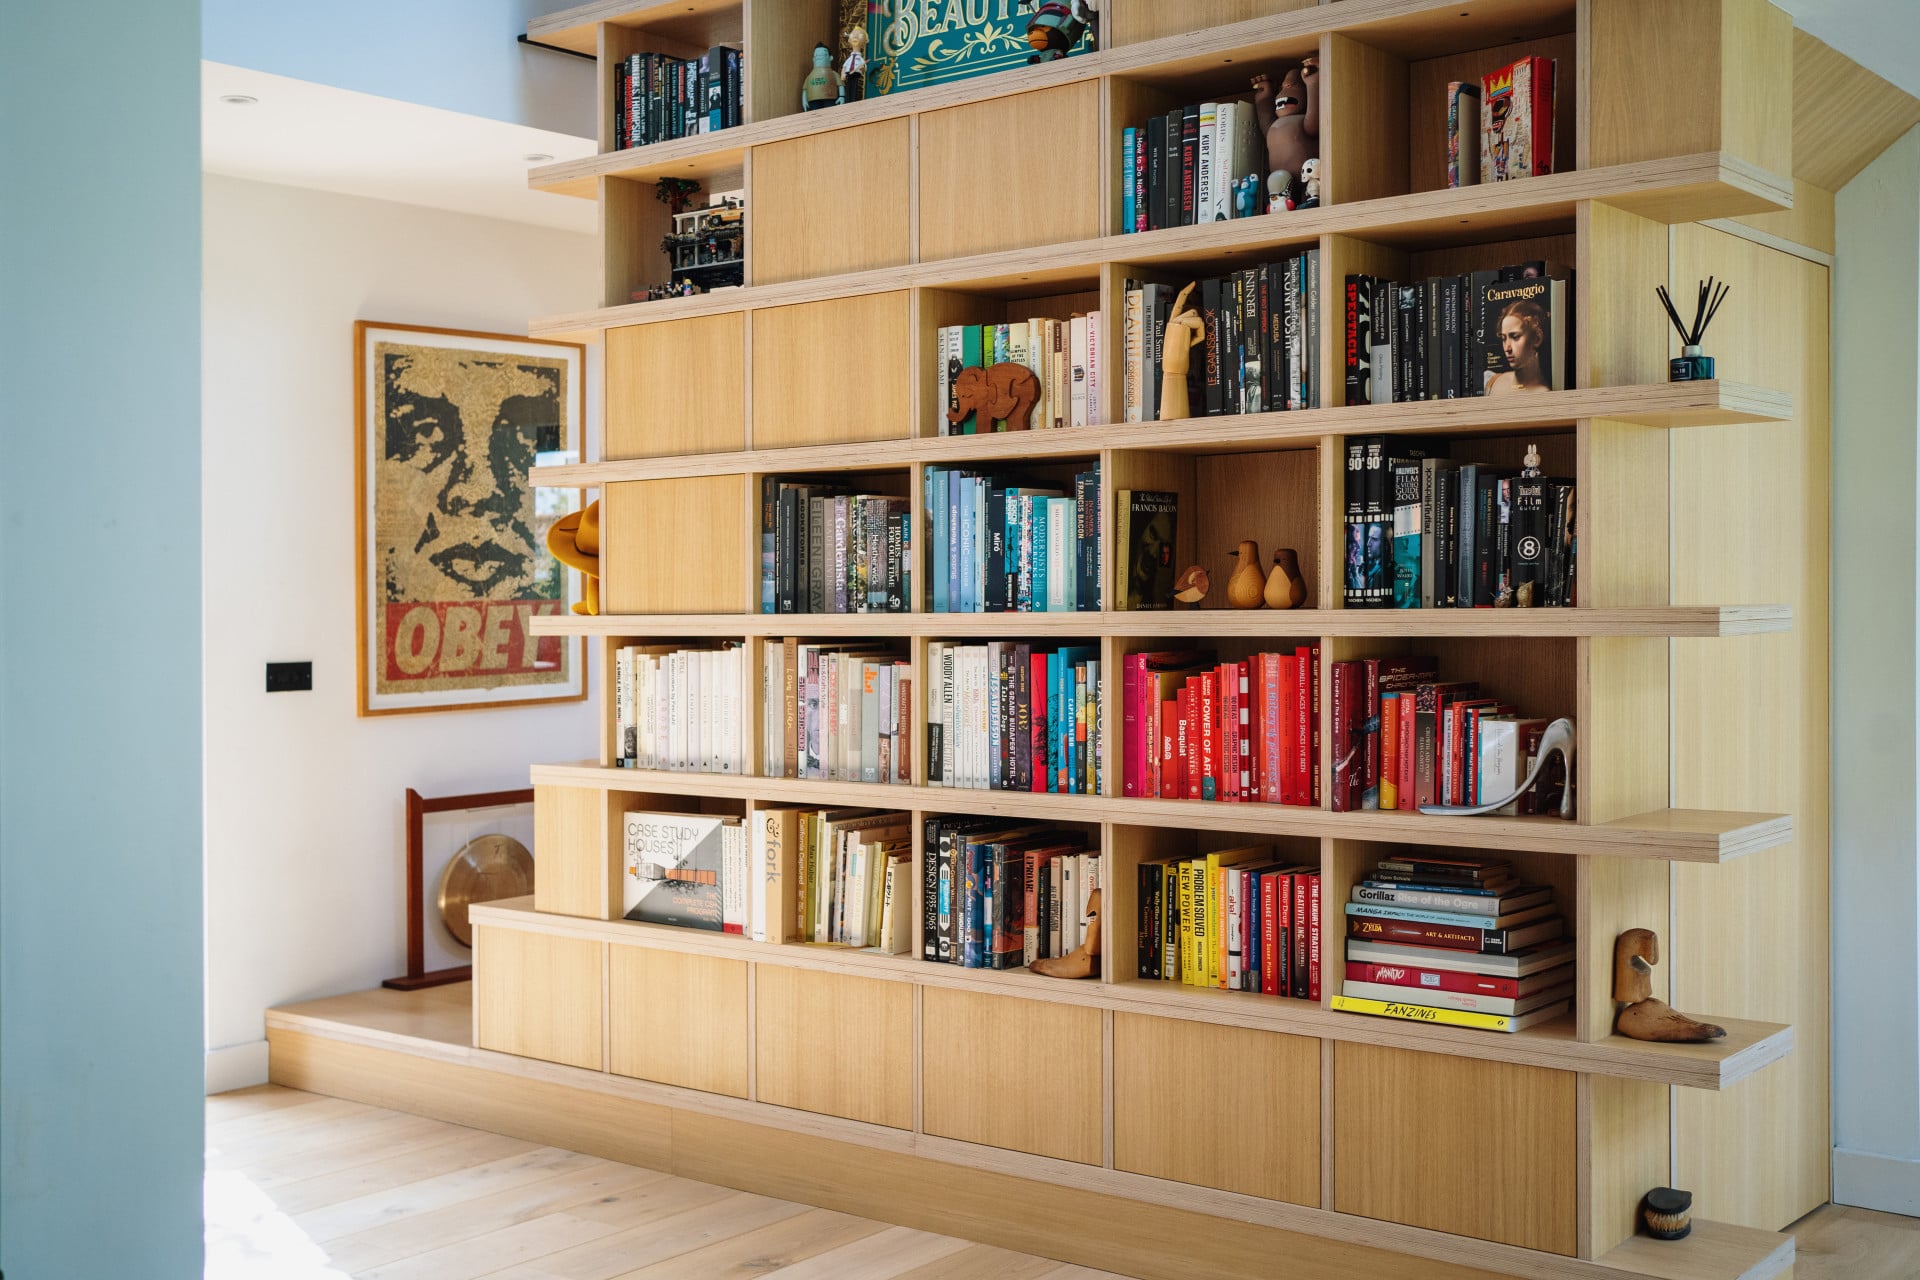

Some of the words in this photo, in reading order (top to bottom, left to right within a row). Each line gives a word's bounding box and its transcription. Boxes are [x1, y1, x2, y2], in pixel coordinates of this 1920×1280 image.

[883, 0, 1040, 56] BEAU
[632, 96, 640, 141] THOMPSON
[1184, 146, 1192, 168] KURT
[1201, 134, 1210, 157] KURT
[1136, 179, 1144, 209] Nothing
[1184, 169, 1192, 211] ANDERSEN
[1201, 159, 1209, 203] ANDERSEN
[1246, 271, 1255, 318] BERNINI
[1487, 284, 1545, 301] Caravaggio
[1128, 295, 1141, 349] DEATH
[1155, 320, 1163, 338] Paul
[1347, 283, 1357, 366] SPECTACLE
[1155, 339, 1163, 363] Smith
[1206, 309, 1216, 373] GAINSBOOK
[1128, 360, 1136, 408] COMPANION
[1207, 377, 1216, 385] LE
[1396, 475, 1419, 483] FILM
[1132, 504, 1157, 512] FRANCIS
[1517, 497, 1541, 505] Film
[812, 500, 822, 556] EILEEN
[835, 517, 845, 591] Gardenista
[1523, 540, 1534, 556] 8
[812, 567, 822, 610] GRAY
[394, 603, 554, 675] OBEY
[944, 654, 952, 680] WOODY
[944, 681, 952, 703] ALLEN
[991, 672, 999, 692] WES
[991, 695, 999, 746] ANDERSON
[944, 711, 952, 768] RETROSPECTIVE
[1178, 720, 1186, 756] Basquiat
[1203, 740, 1210, 753] OF
[628, 823, 658, 838] CASE
[662, 825, 699, 840] STUDY
[628, 839, 674, 854] HOUSES
[767, 839, 780, 883] fork
[1026, 856, 1034, 892] UPROAR!
[1194, 869, 1204, 906] PROBLEM
[1182, 894, 1190, 932] POWER
[1229, 896, 1237, 915] aha!
[1296, 885, 1304, 925] CREATIVITY,
[1355, 906, 1383, 915] MANGA
[1359, 889, 1395, 902] Gorillaz
[1397, 894, 1421, 904] Rise
[1423, 896, 1433, 904] of
[1434, 896, 1450, 907] the
[1454, 898, 1479, 910] Ogre
[1194, 907, 1204, 936] SOLVED
[1297, 926, 1305, 940] INC.
[1444, 933, 1475, 942] ARTIFACTS
[1383, 1002, 1438, 1020] FANZINES
